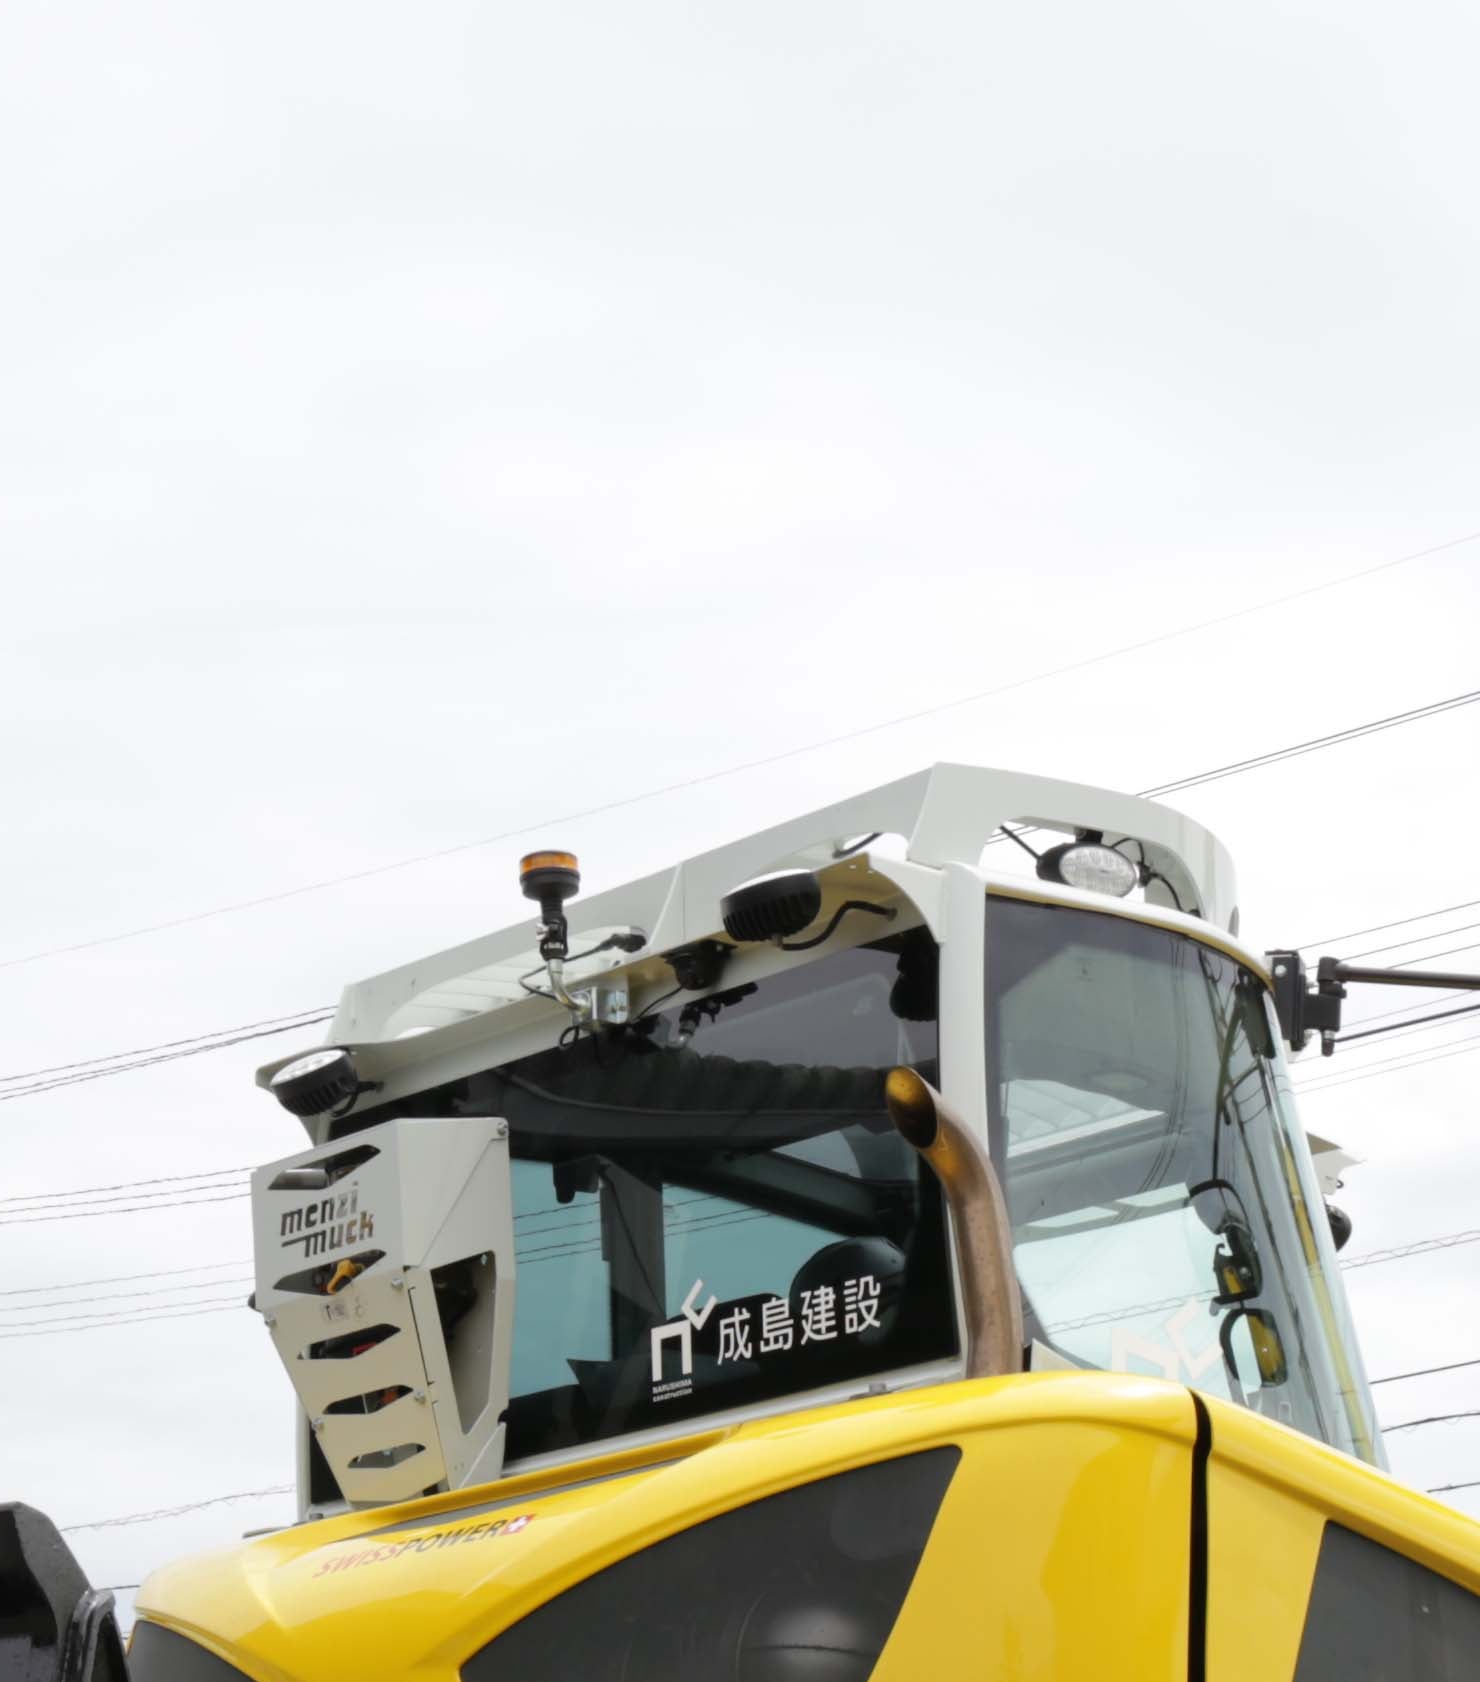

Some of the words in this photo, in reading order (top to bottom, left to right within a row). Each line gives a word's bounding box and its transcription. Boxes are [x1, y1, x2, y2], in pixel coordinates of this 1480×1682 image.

[280, 1181, 359, 1236] menzi
[281, 1211, 374, 1258] muck
[717, 1275, 881, 1366] 成島建設
[311, 1519, 508, 1579] SWISSPOWER
